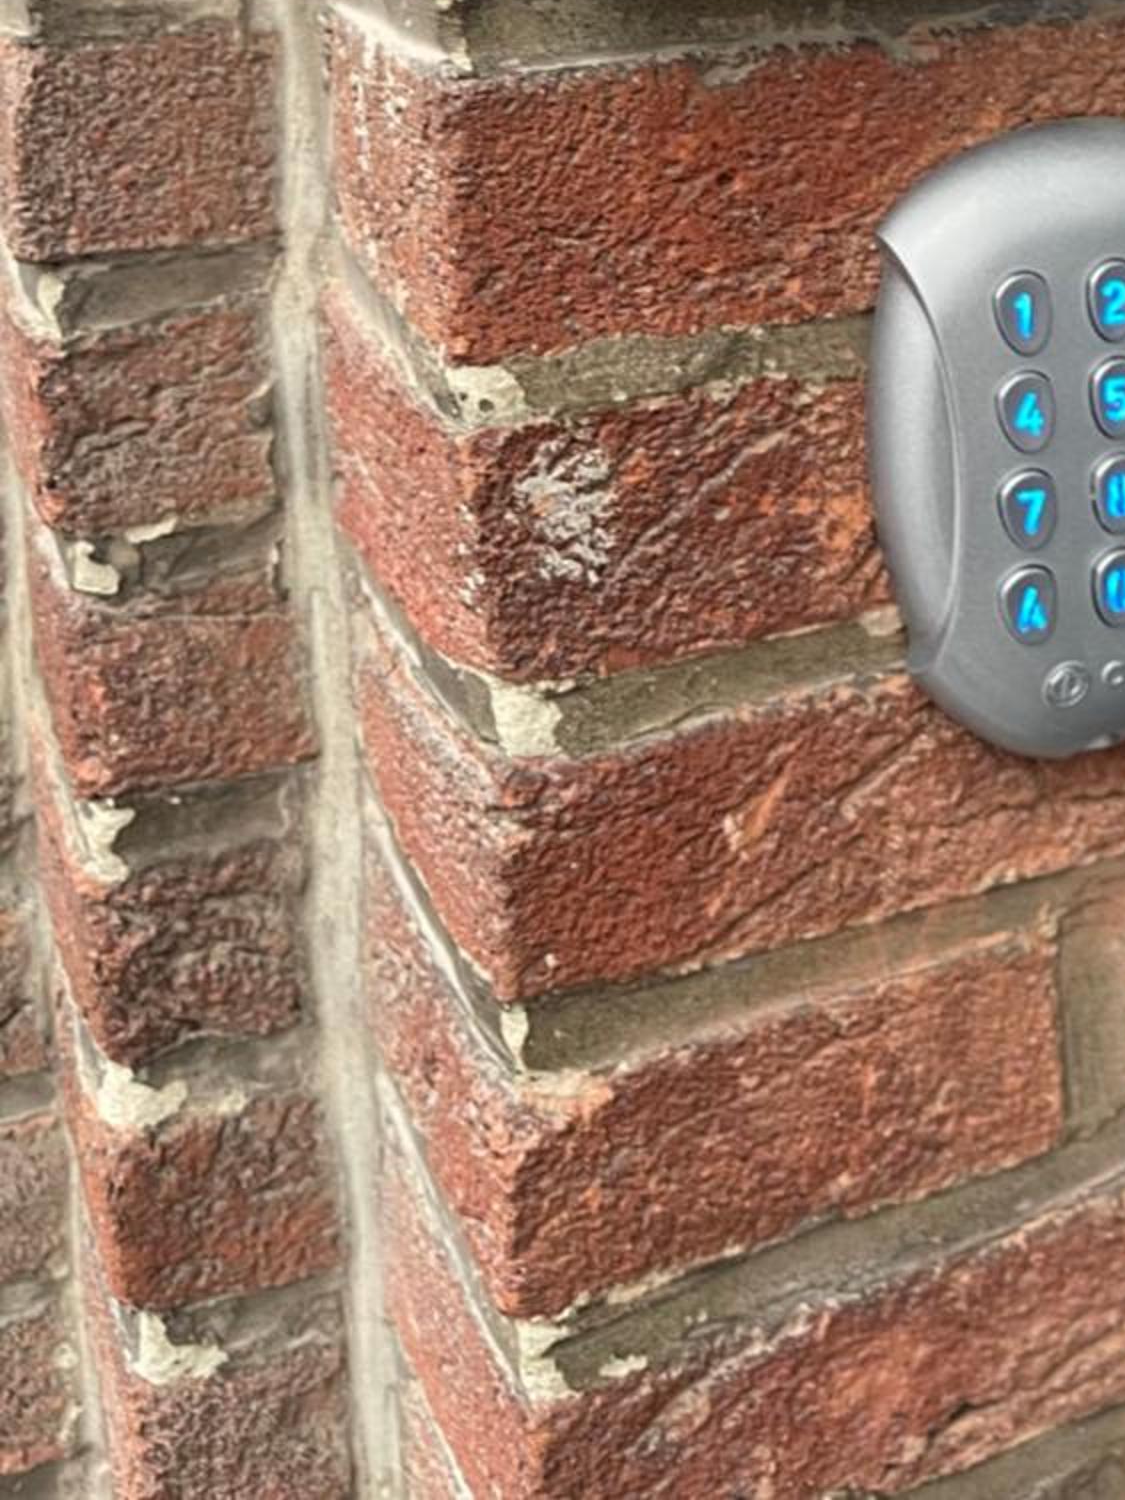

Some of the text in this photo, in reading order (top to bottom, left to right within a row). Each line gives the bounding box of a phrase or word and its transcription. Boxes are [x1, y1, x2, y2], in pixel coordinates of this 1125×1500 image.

[1012, 291, 1035, 340] 1
[1014, 391, 1045, 436] 4
[1015, 488, 1047, 535] 7
[1016, 585, 1048, 633] A
